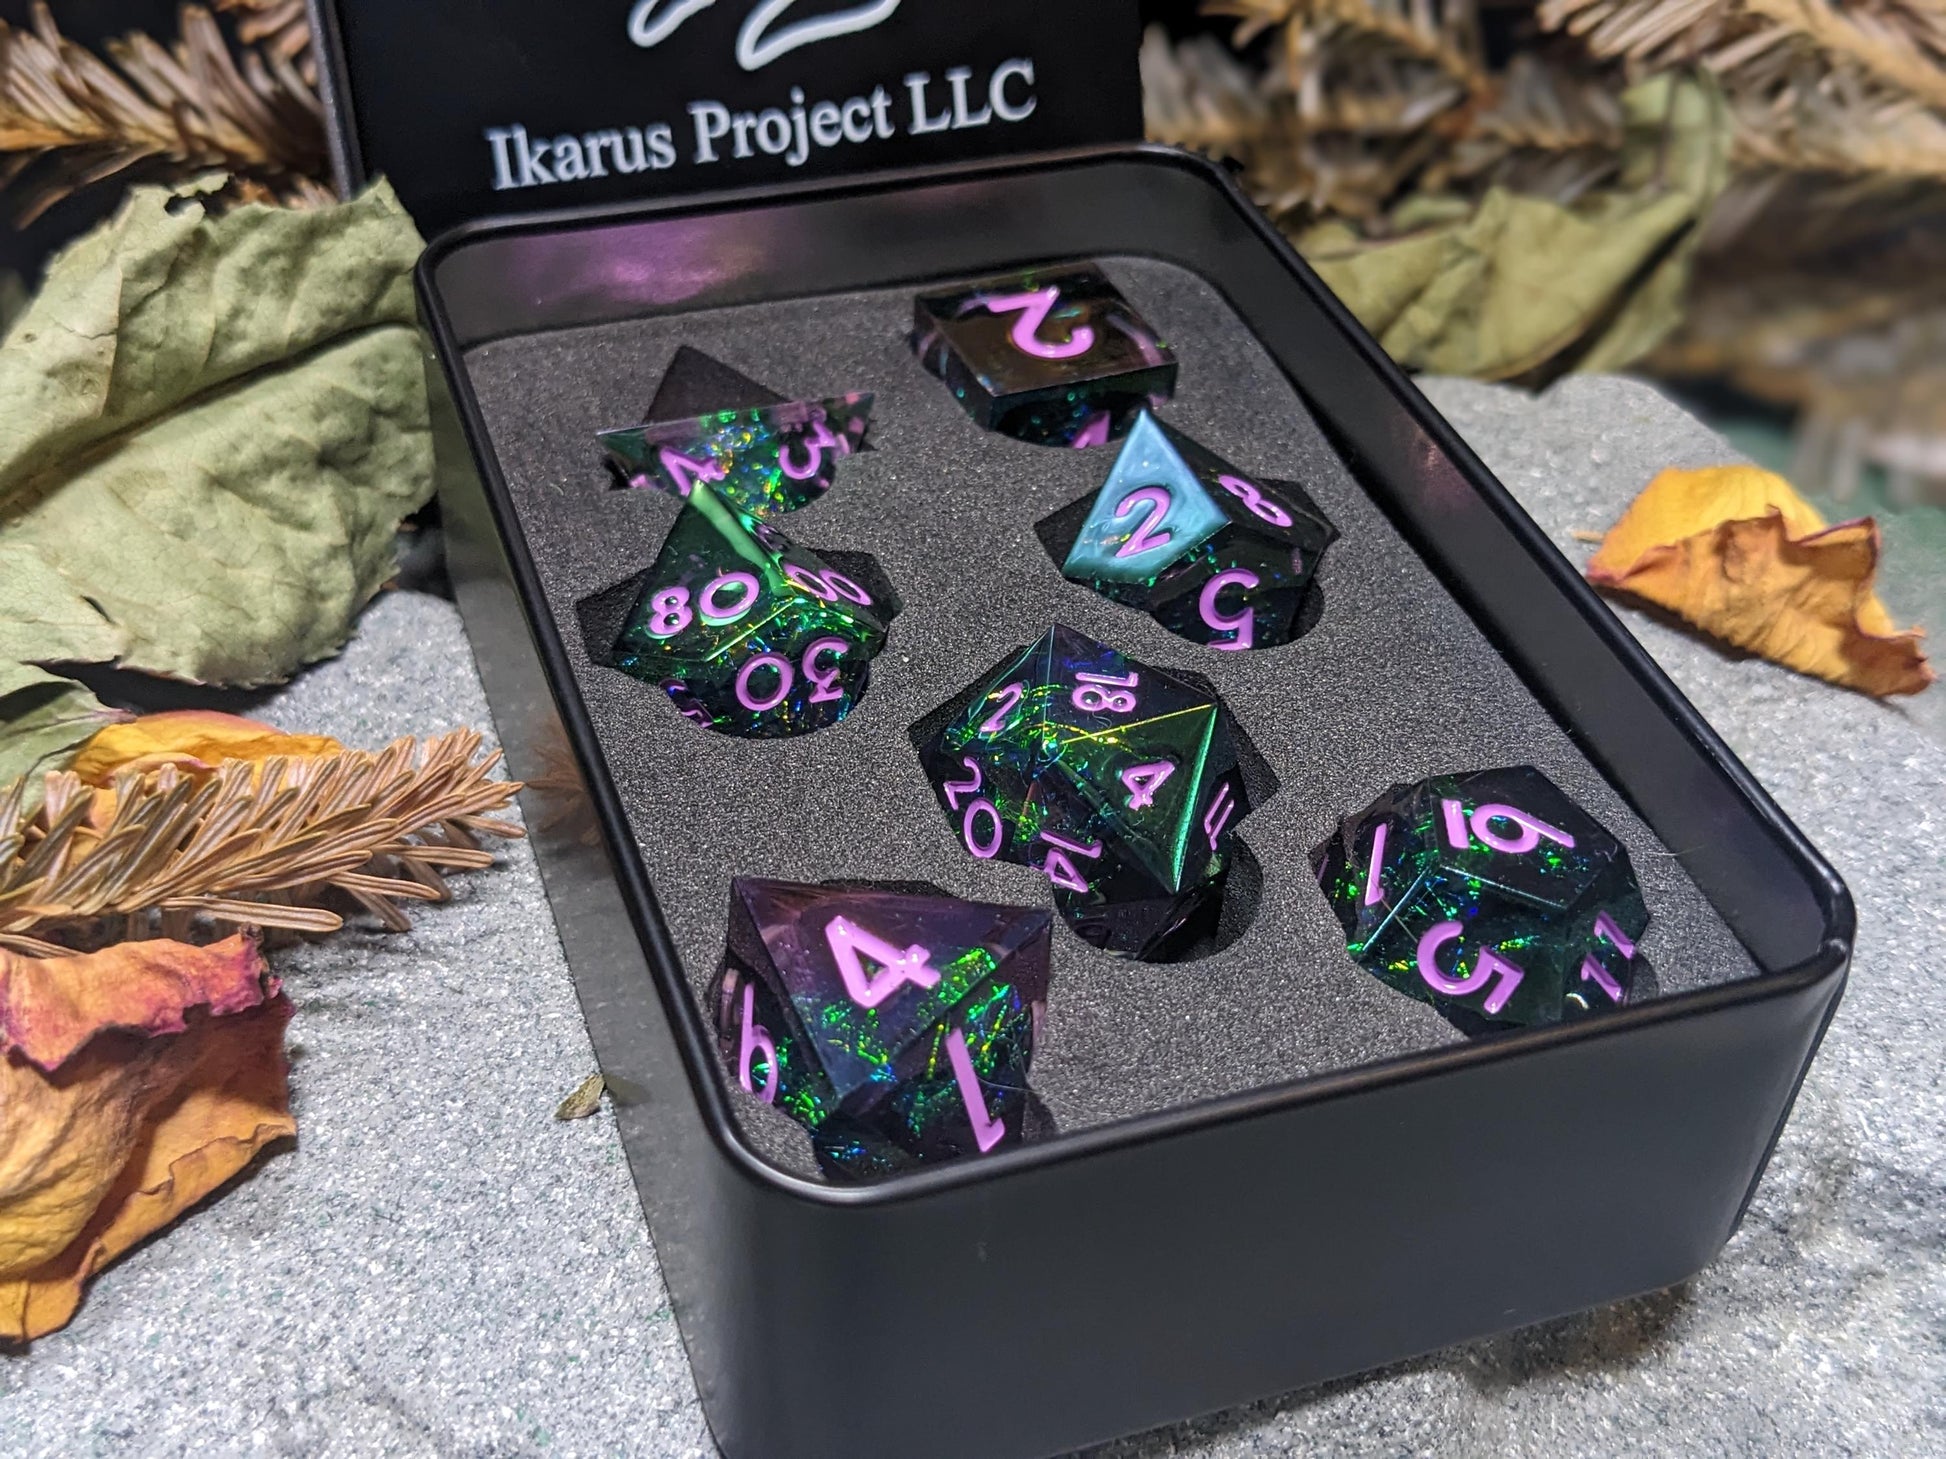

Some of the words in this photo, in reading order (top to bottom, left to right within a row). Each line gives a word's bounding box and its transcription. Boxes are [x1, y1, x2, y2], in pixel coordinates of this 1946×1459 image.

[484, 122, 677, 191] Ikarus
[690, 85, 895, 168] Project
[904, 58, 1037, 136] LLC
[987, 285, 1096, 359] 2
[1114, 486, 1172, 559] 2
[1218, 474, 1294, 528] 8
[645, 571, 760, 637] 80
[1199, 567, 1260, 651] 5
[735, 636, 850, 712] 30
[979, 682, 1023, 733] 2
[1071, 671, 1140, 713] 18
[943, 755, 1003, 859] 20
[1121, 759, 1177, 811] 4
[1030, 830, 1102, 894] 14
[1364, 822, 1388, 907] 1
[824, 914, 942, 1009] 4
[1416, 920, 1525, 1015] 5
[1580, 909, 1637, 1004] 11
[945, 1026, 1006, 1154] 1
